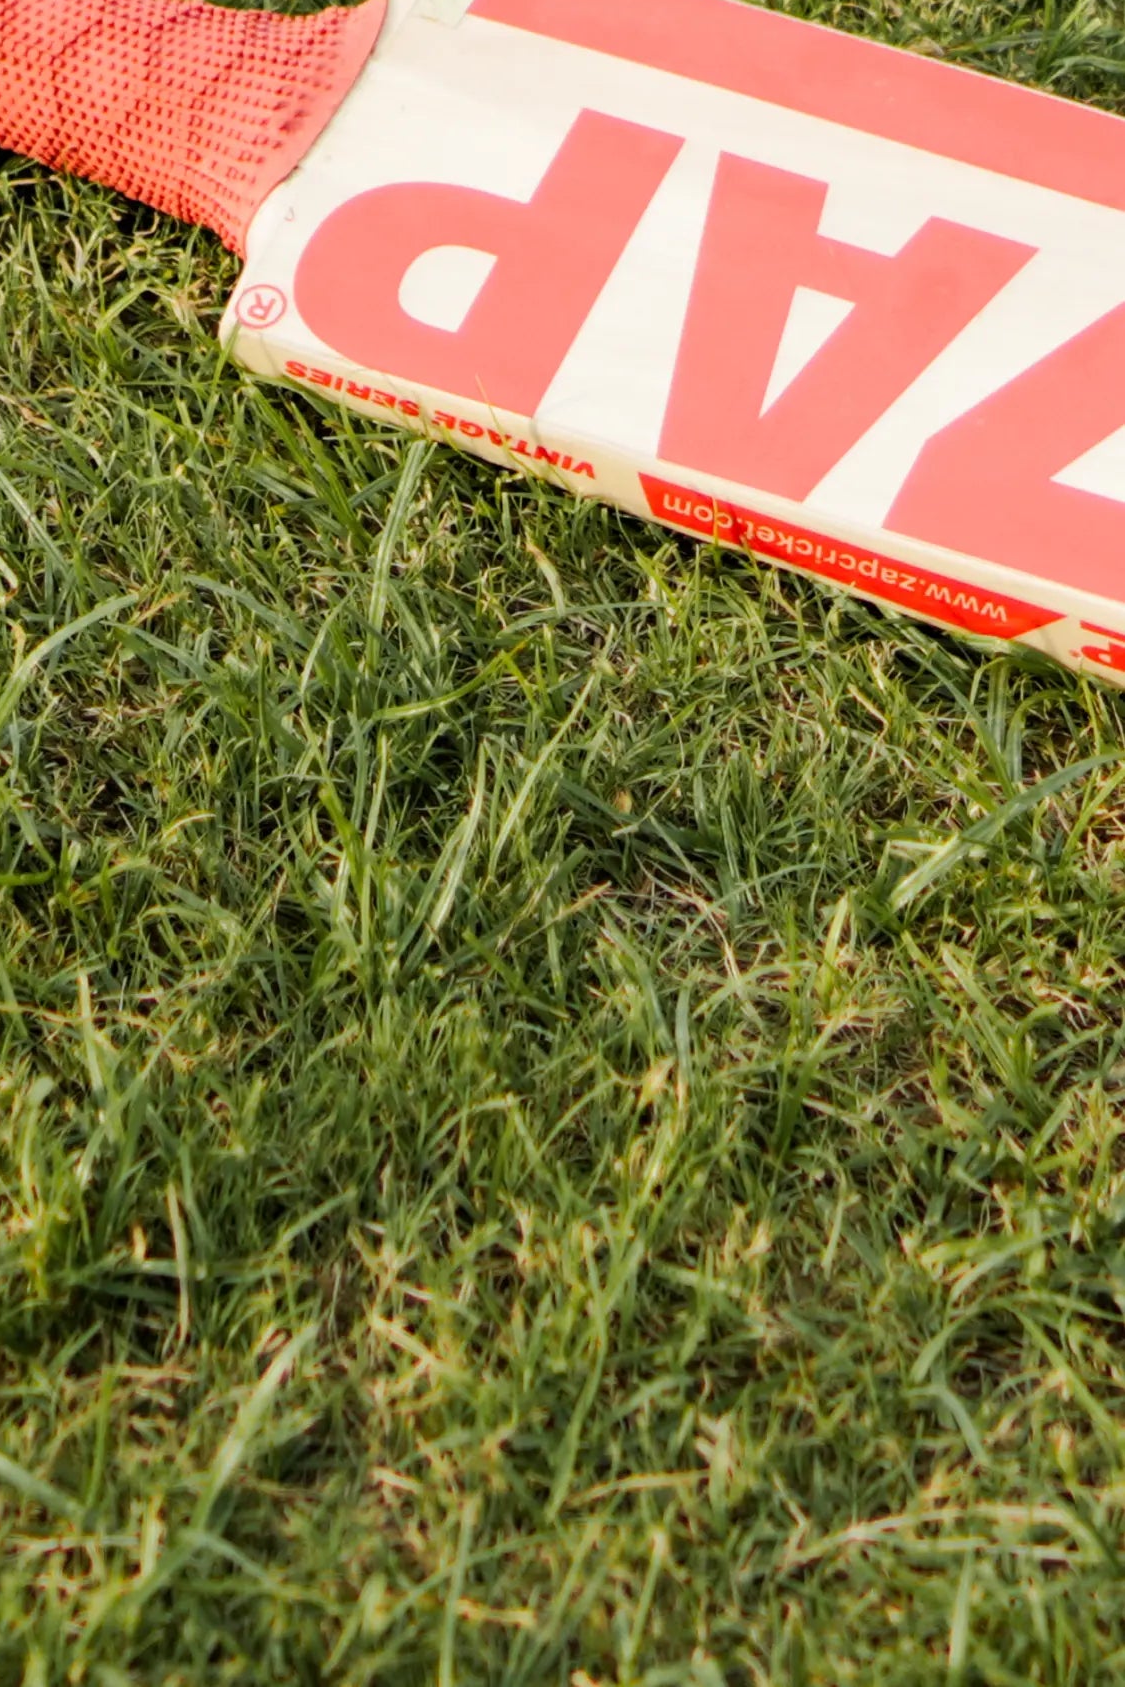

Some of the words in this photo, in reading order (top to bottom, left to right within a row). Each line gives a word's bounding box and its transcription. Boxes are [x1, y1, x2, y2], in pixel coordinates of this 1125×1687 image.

[285, 359, 421, 418] SERIES
[433, 409, 596, 480] VINTAGE
[662, 492, 1008, 624] www.zapcricket.com
